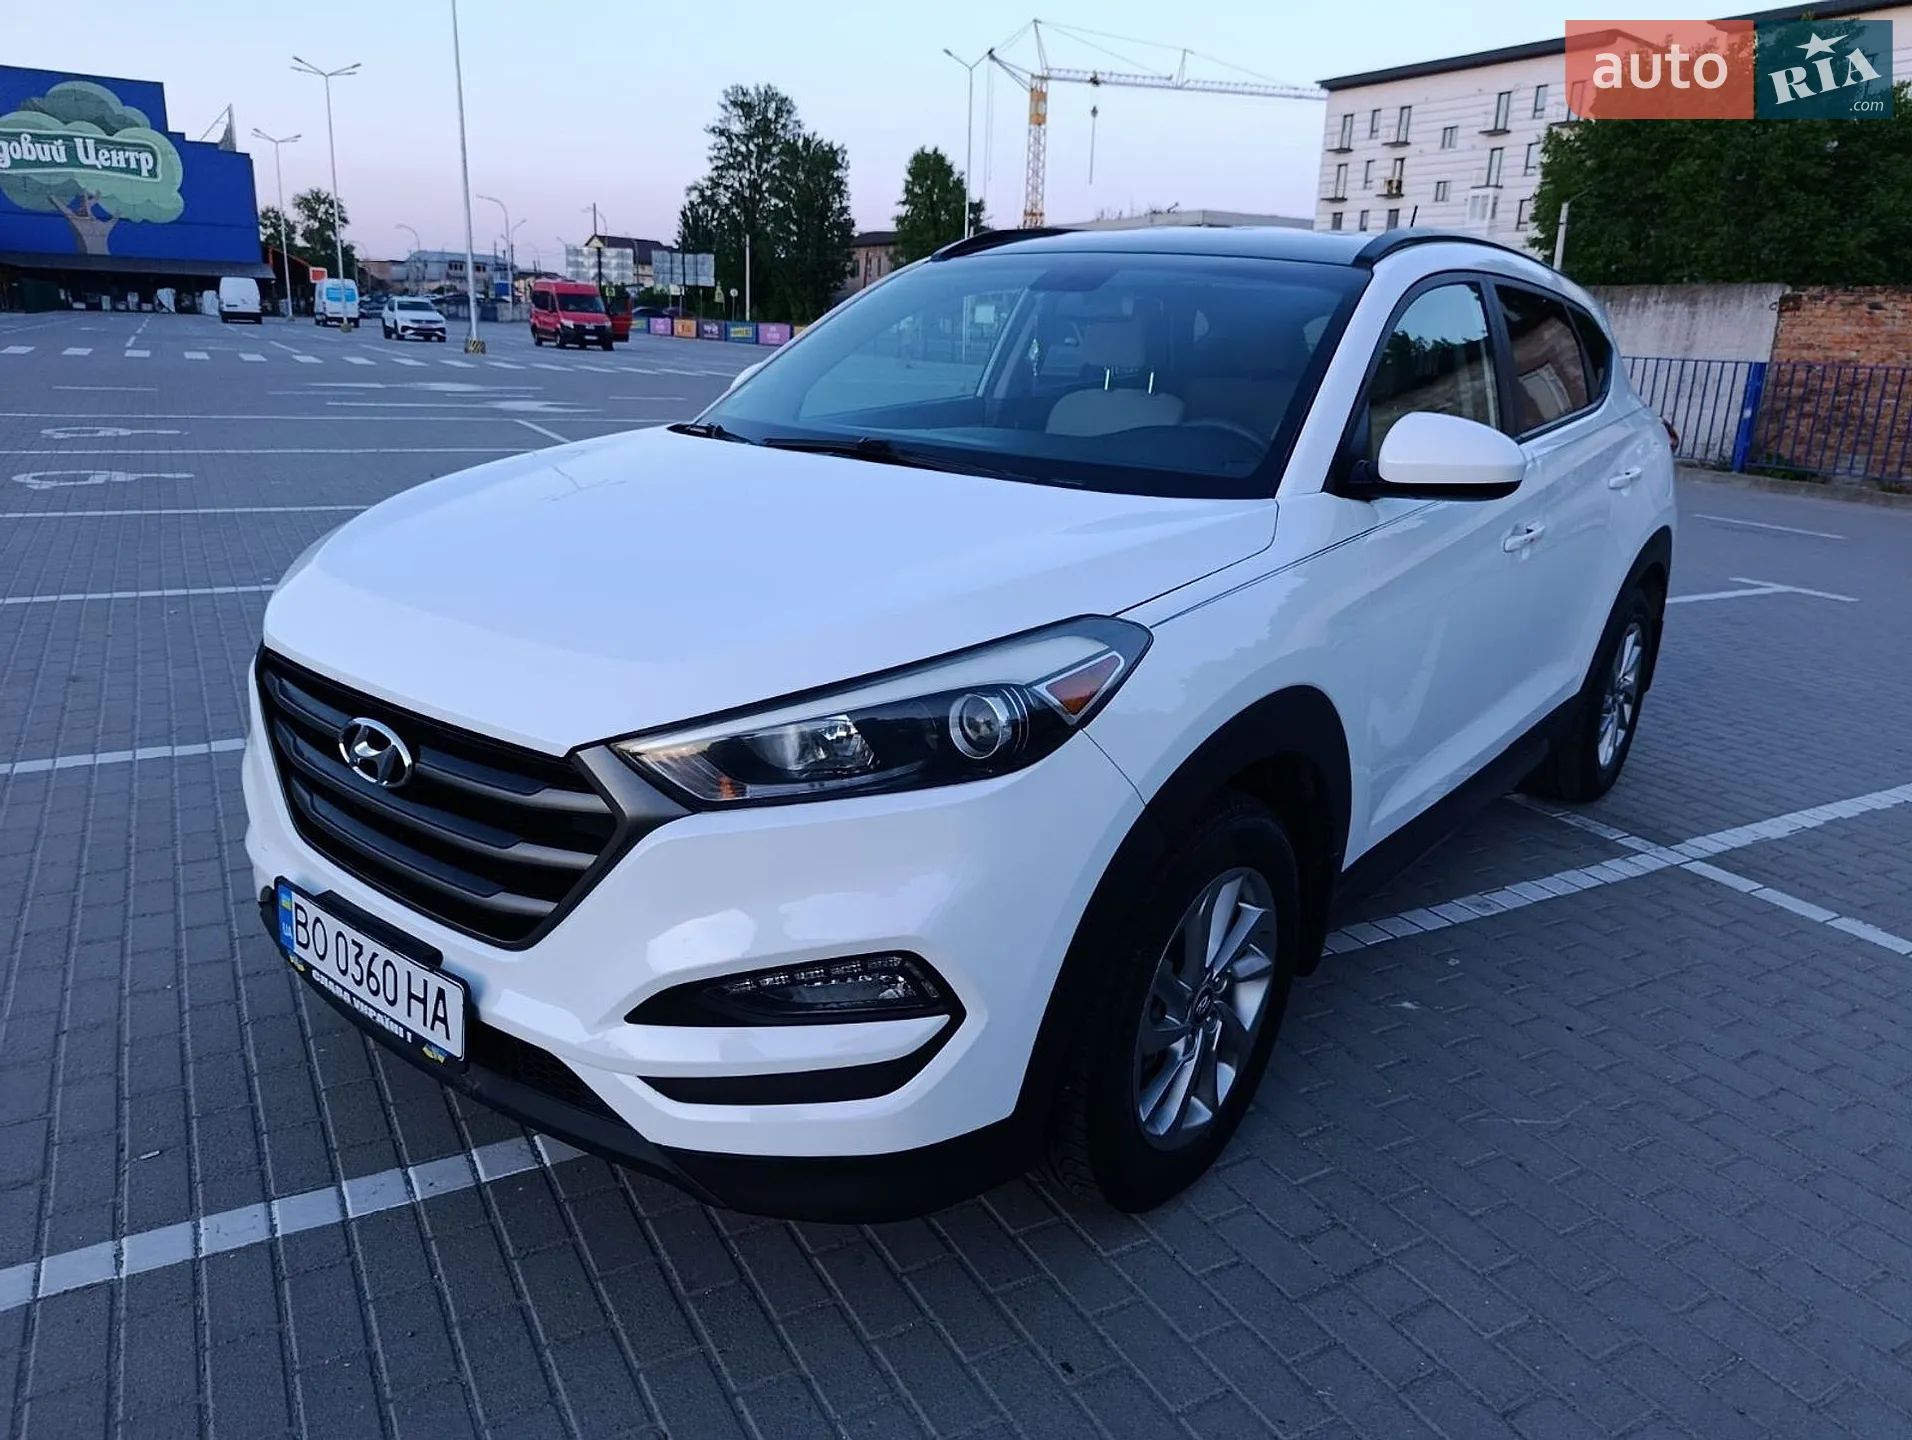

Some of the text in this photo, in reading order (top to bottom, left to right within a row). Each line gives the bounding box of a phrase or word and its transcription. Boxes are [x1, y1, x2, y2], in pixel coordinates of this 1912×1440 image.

[73, 138, 154, 177] Центр
[282, 922, 293, 940] UA
[335, 930, 398, 1007] 0360
